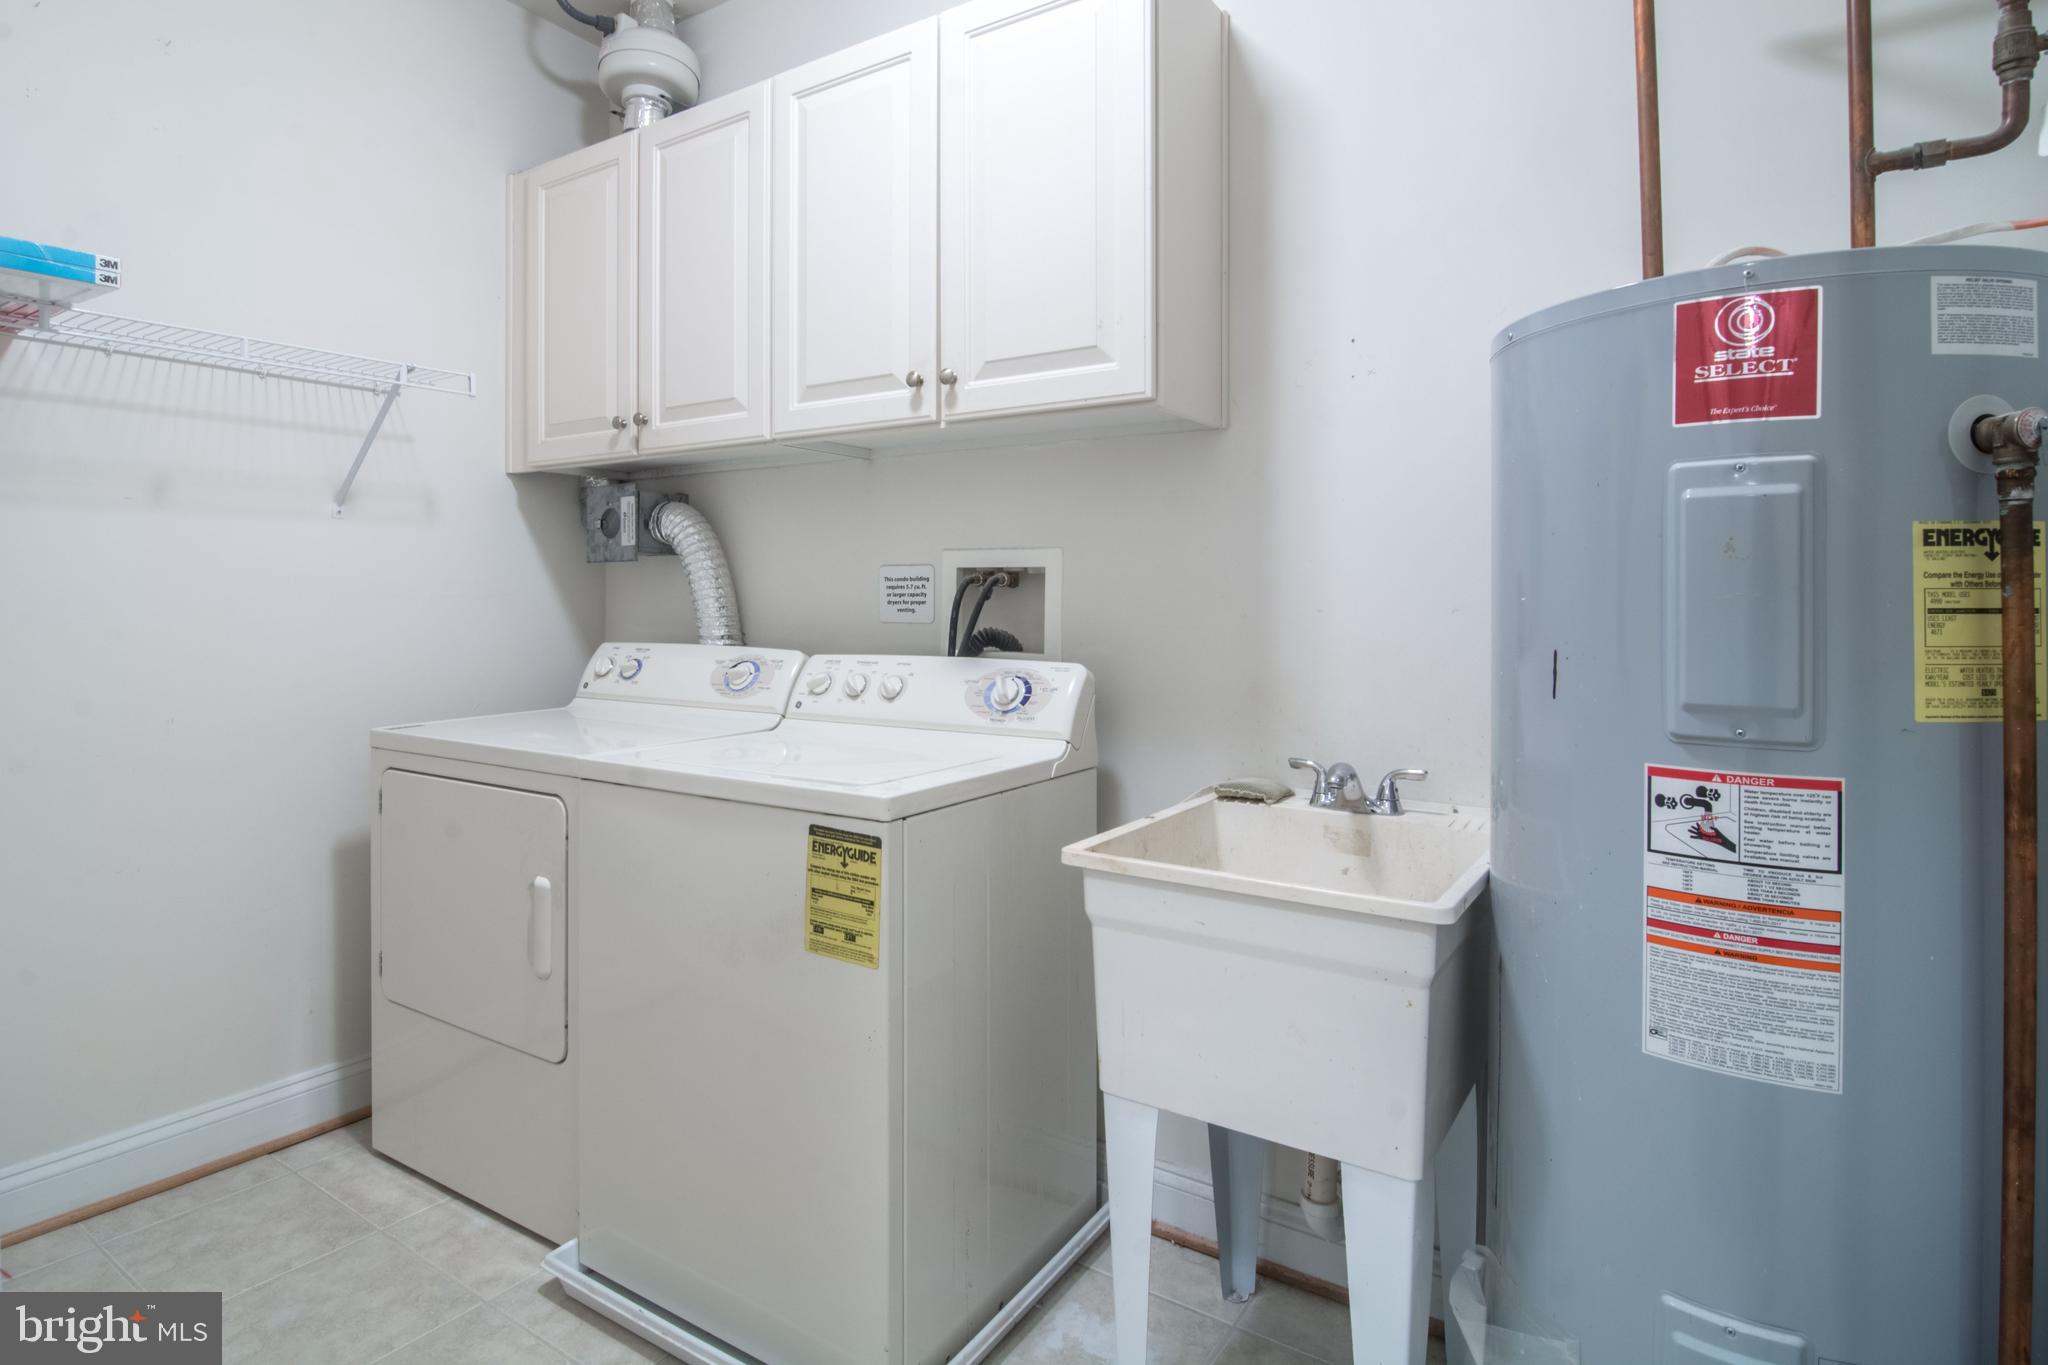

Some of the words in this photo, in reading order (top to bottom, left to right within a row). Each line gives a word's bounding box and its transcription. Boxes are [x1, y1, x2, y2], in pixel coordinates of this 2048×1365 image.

[99, 259, 118, 270] 3M
[99, 274, 118, 284] 3M
[1714, 346, 1775, 361] state
[1694, 359, 1794, 379] SELECT
[1710, 407, 1722, 415] The
[1726, 775, 1775, 786] DANGER
[812, 840, 877, 864] ENERGYGUIDE
[1723, 934, 1758, 944] DANGER
[1723, 952, 1758, 961] WARNING
